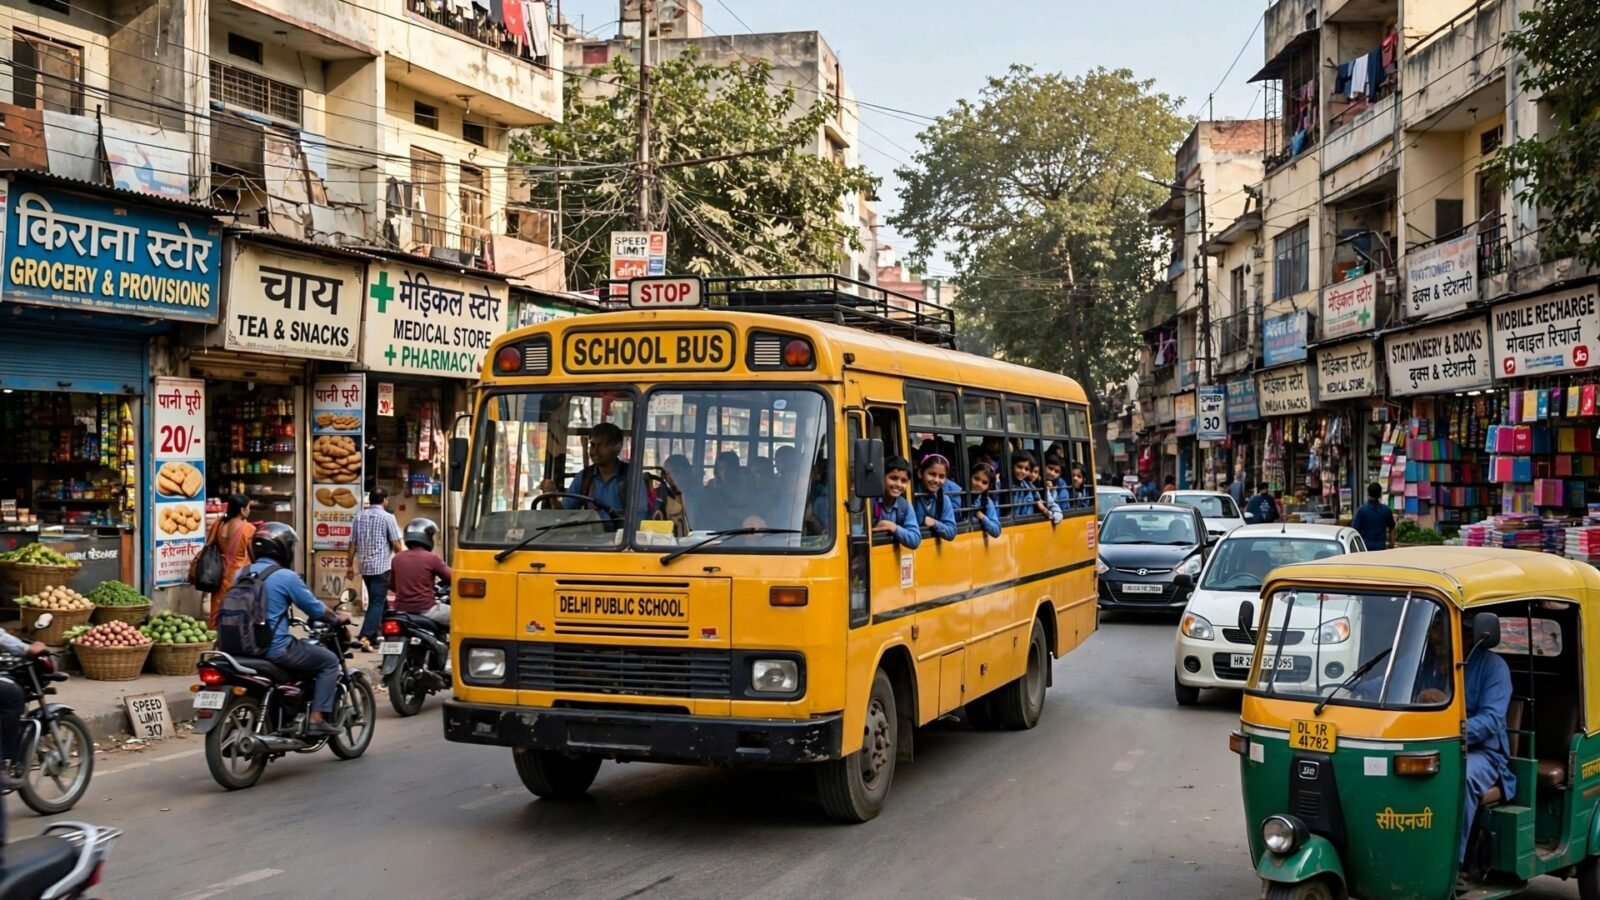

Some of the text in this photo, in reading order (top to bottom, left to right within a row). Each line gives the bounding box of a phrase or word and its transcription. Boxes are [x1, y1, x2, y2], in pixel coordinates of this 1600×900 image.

[15, 192, 213, 274] किराना स्टोर
[614, 236, 648, 246] SPEED
[10, 256, 99, 293] GROCERY
[102, 270, 114, 296] &
[119, 272, 210, 308] PROVISIONS
[259, 265, 344, 315] चाय
[640, 283, 691, 303] STOP
[1433, 284, 1440, 300] &
[469, 286, 502, 322] स्टोर
[1496, 293, 1595, 332] MOBILE RECHARGE
[238, 314, 349, 347] TEA & SNACKS
[393, 319, 491, 349] MEDICAL STORE
[1444, 335, 1451, 355] &
[1452, 329, 1482, 354] BOOKS
[1506, 318, 1581, 354] मोबाइल रिचार्ज
[401, 346, 476, 372] PHARMACY
[573, 335, 723, 365] SCHOOL BUS
[1409, 366, 1430, 389] बुक्स
[1432, 363, 1440, 380] &
[158, 389, 202, 415] पानी पूरी
[315, 384, 359, 408] पानी पूरी
[1203, 416, 1220, 430] 30
[160, 425, 201, 455] 20/-
[560, 595, 684, 617] DELHI PUBLIC SCHOOL
[1234, 656, 1244, 666] HR
[1246, 657, 1253, 666] 2
[132, 698, 162, 712] SPEED
[138, 711, 163, 724] LIMIT
[144, 723, 163, 737] 30
[1297, 722, 1327, 736] DL 1R
[1376, 806, 1433, 832] सीएनजी
